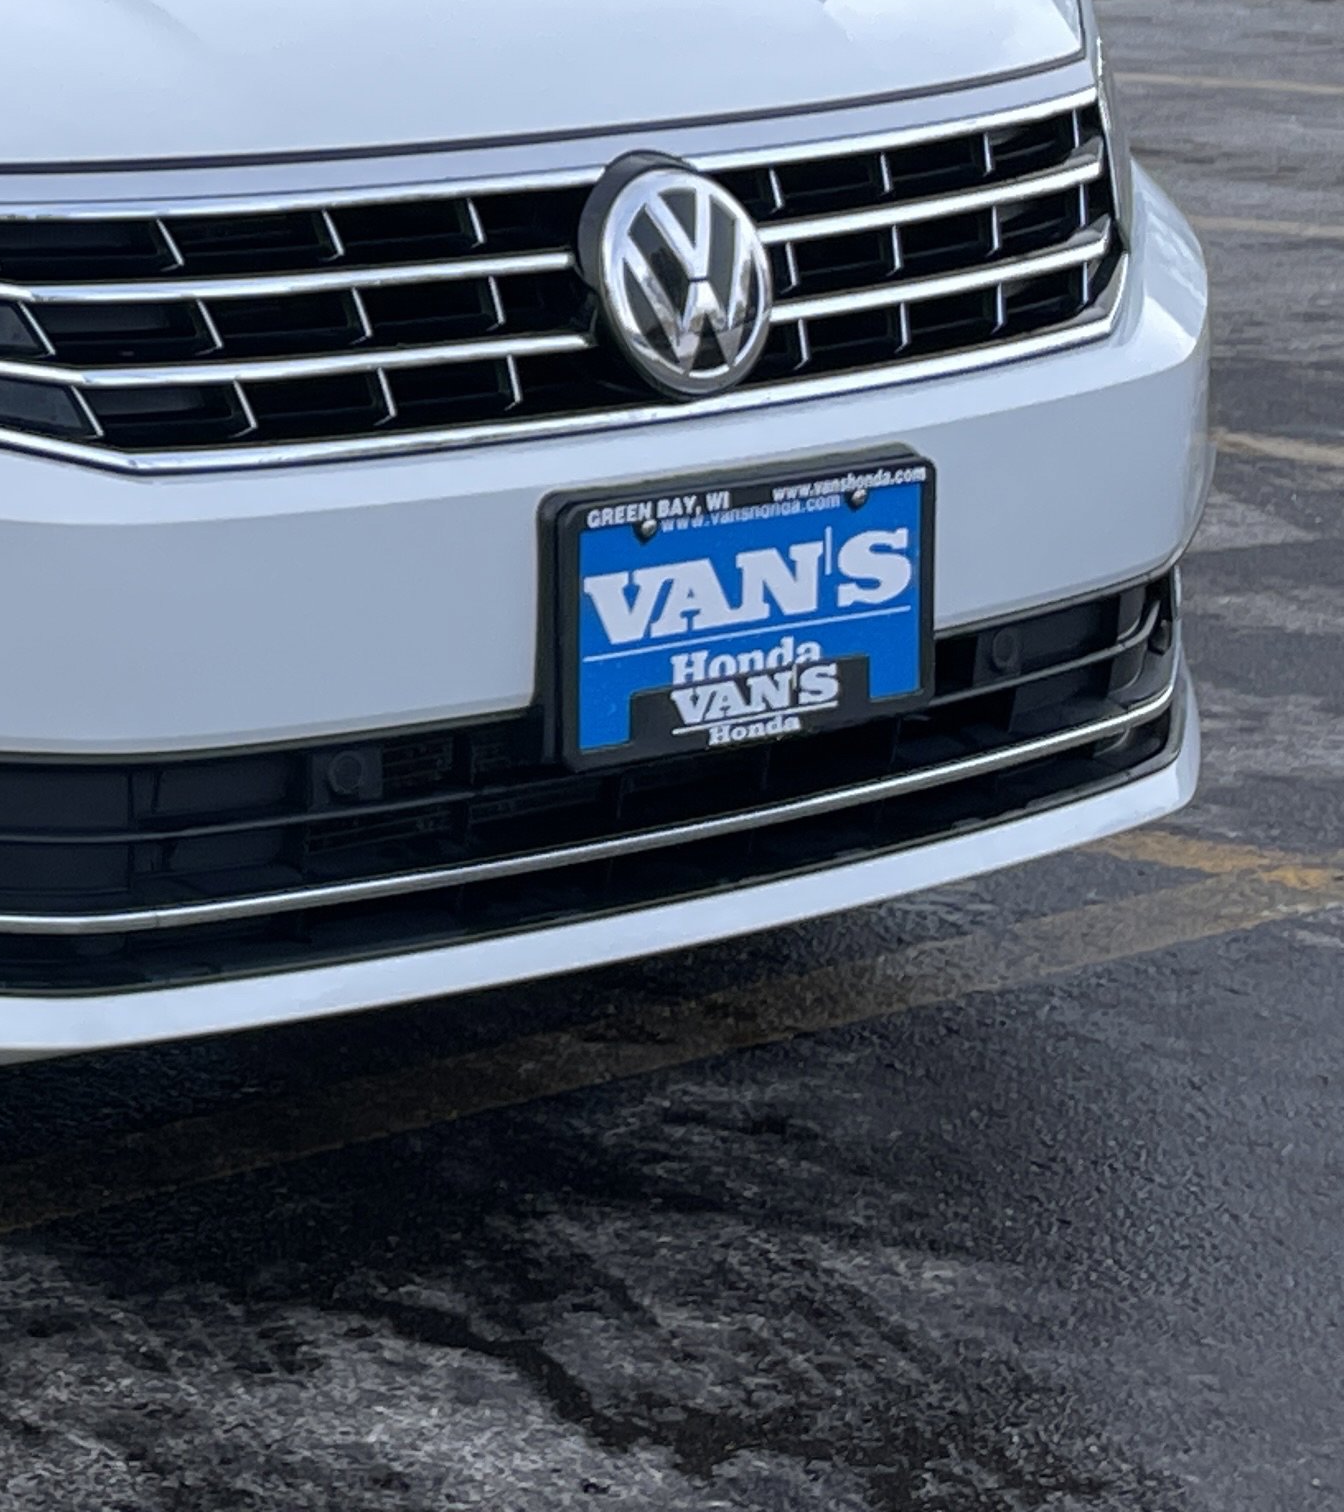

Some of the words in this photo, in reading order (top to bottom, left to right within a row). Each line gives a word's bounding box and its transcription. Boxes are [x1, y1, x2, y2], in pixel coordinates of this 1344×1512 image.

[772, 466, 927, 502] www.vanshonda.com
[587, 501, 653, 529] GREEN
[656, 495, 702, 519] BAY,
[706, 491, 730, 512] WI
[583, 525, 912, 645] VAN'S
[670, 636, 821, 685] Honda
[670, 662, 839, 725] VAN'S
[708, 715, 801, 746] Honda
